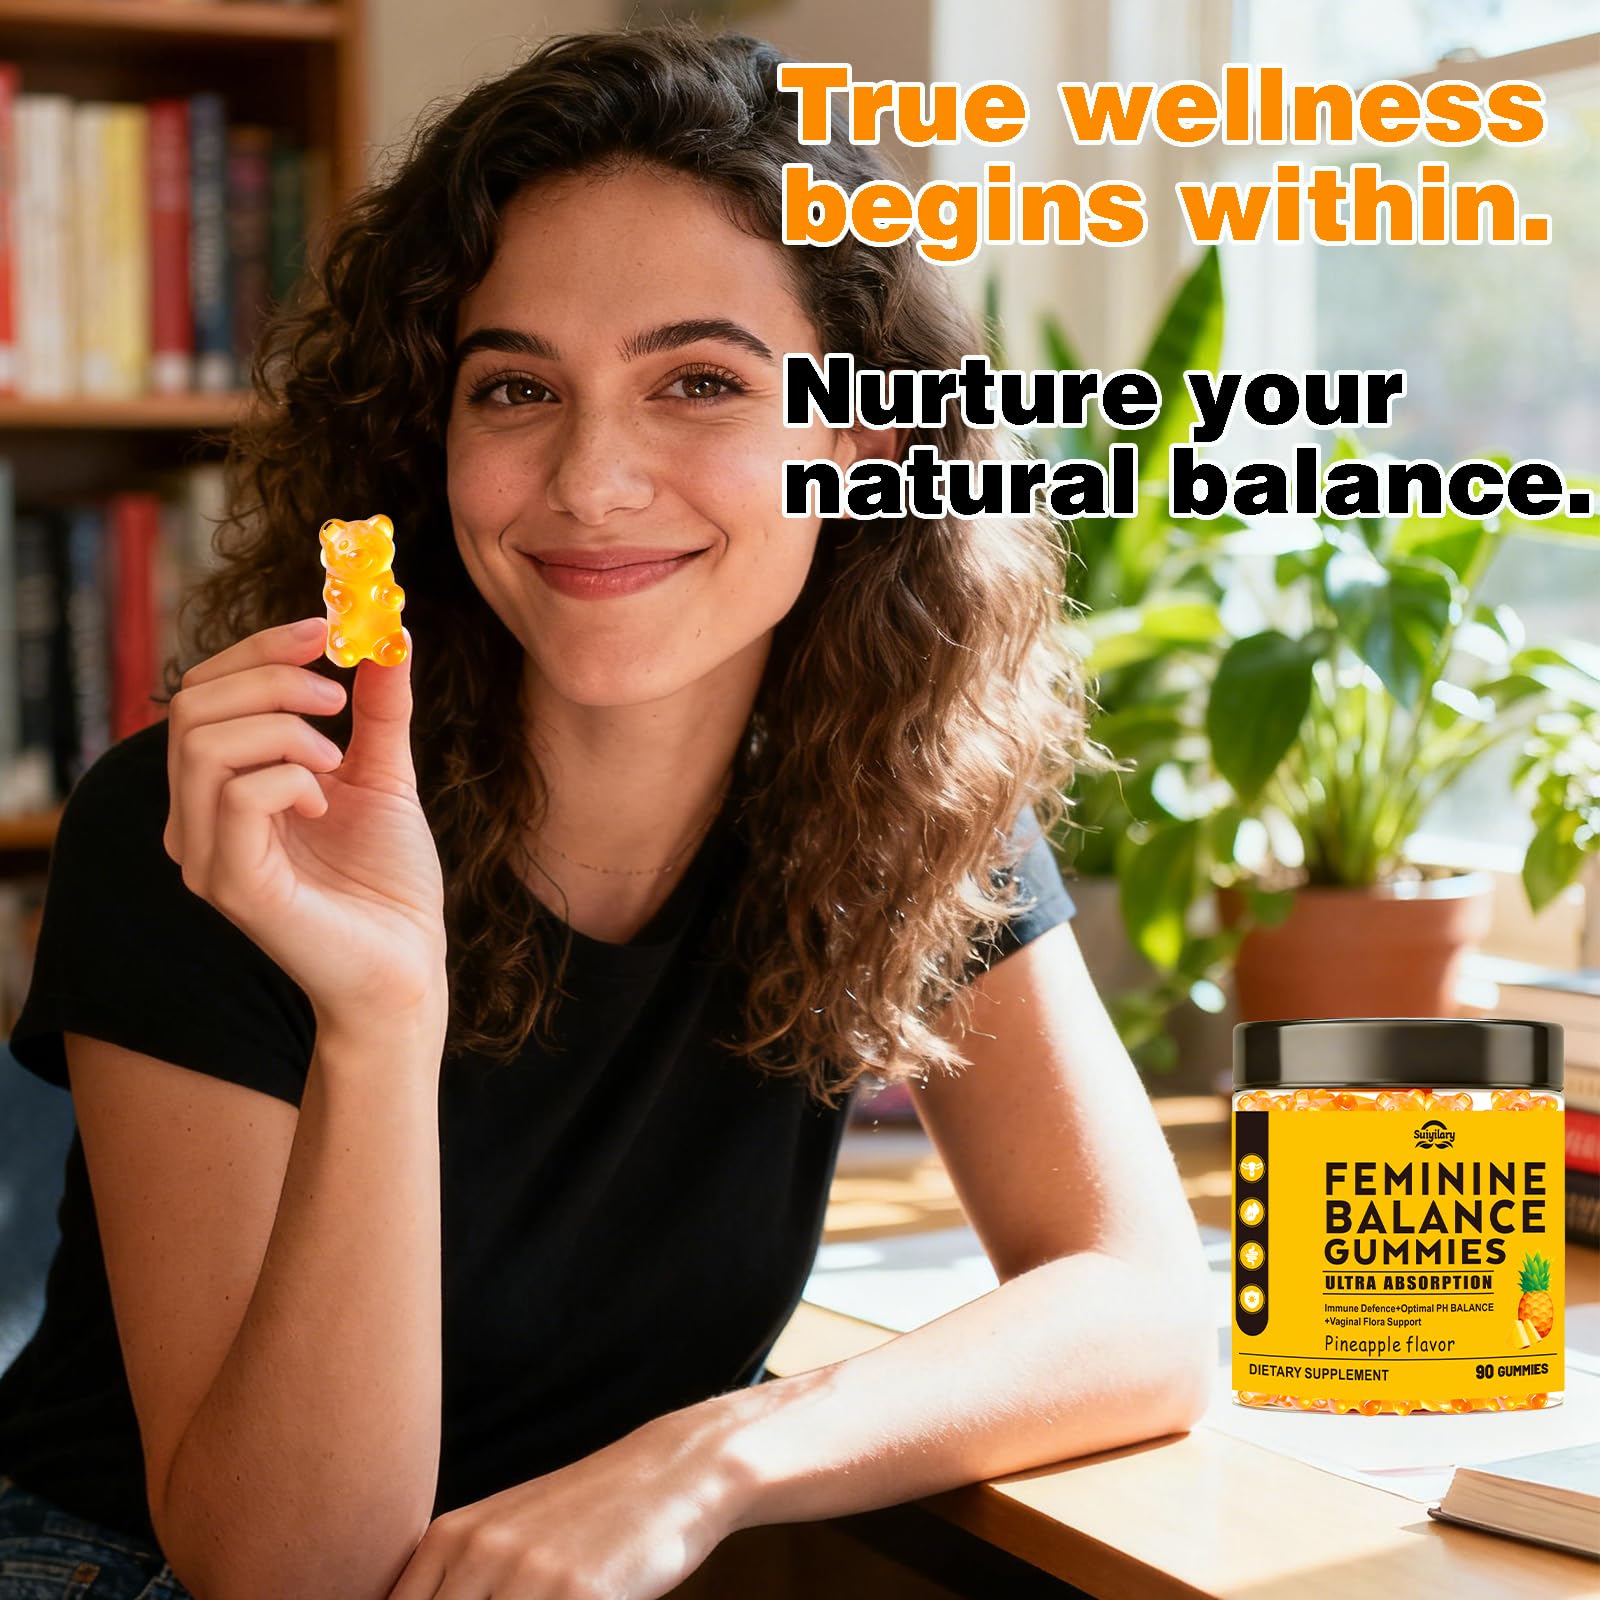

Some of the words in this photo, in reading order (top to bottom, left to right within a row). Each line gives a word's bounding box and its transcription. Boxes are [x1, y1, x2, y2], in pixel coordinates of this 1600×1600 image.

[1412, 1129, 1456, 1142] Suiyilary
[1326, 1162, 1545, 1195] FEMININE
[1327, 1200, 1545, 1234] BALANCE
[1325, 1238, 1505, 1265] GUMMIES
[1326, 1276, 1376, 1289] ULTRA
[1384, 1276, 1491, 1290] ABSORPTION
[1325, 1304, 1358, 1312] Immune
[1361, 1304, 1434, 1314] Defence+Optimal
[1437, 1304, 1448, 1312] PH
[1451, 1303, 1493, 1312] BALANCE
[1325, 1317, 1361, 1327] +Vaginal
[1364, 1317, 1385, 1326] Flora
[1387, 1318, 1421, 1328] Support
[1326, 1335, 1401, 1355] Pineapple
[1406, 1336, 1455, 1352] flavor
[1250, 1364, 1301, 1378] DIETARY
[1305, 1368, 1389, 1381] SUPPLEMENT
[1476, 1364, 1494, 1379] 90
[1498, 1363, 1548, 1377] GUMMIES
